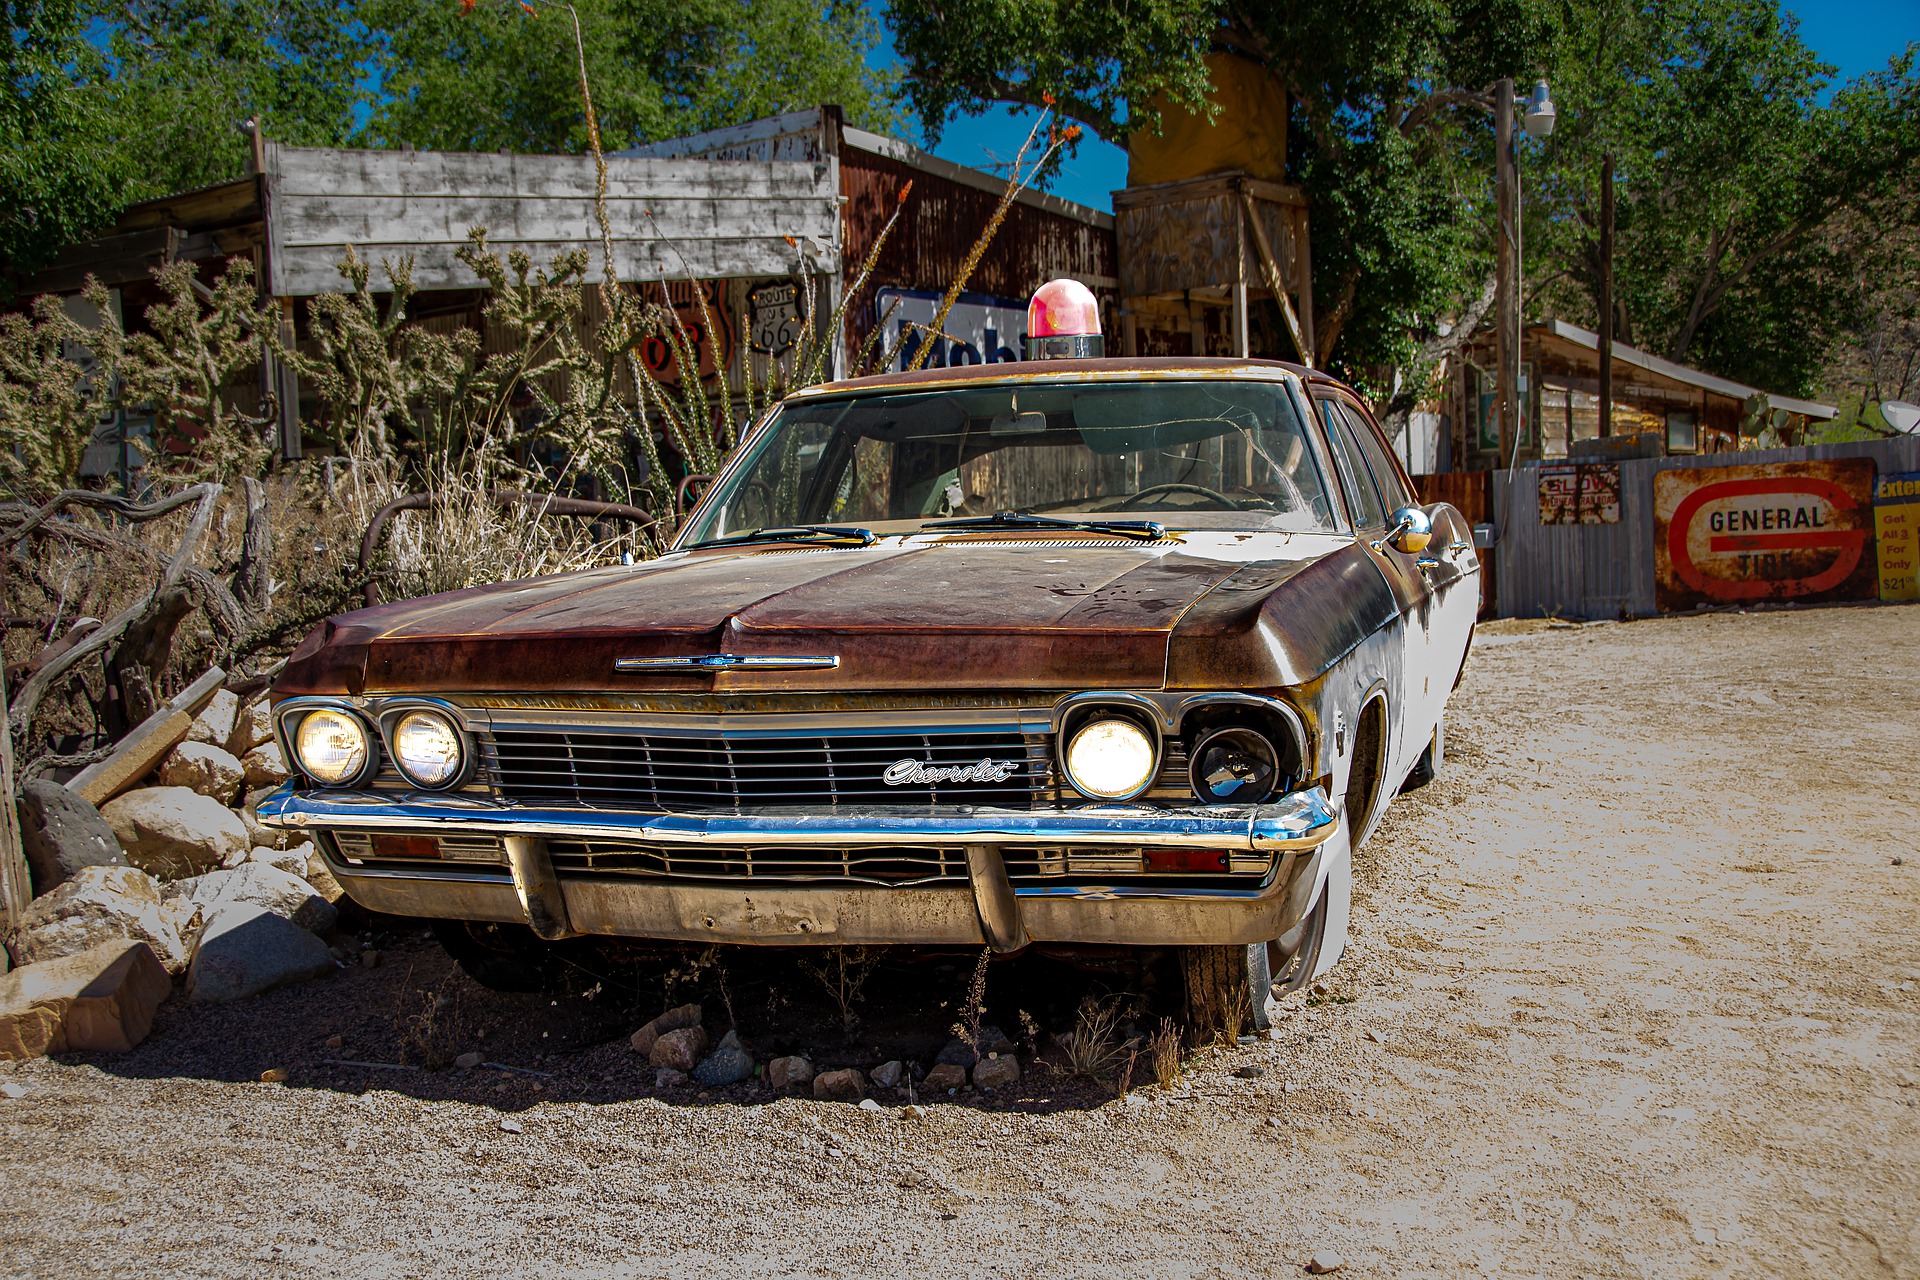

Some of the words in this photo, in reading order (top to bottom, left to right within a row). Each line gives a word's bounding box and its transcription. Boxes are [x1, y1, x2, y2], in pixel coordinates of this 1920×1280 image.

[759, 288, 792, 304] ROUTE
[761, 319, 790, 348] 66
[1547, 477, 1609, 492] SLOW
[1540, 496, 1580, 507] OVERHEA
[1710, 506, 1824, 532] GENERAL
[1883, 514, 1906, 524] Get
[1882, 529, 1898, 539] All
[1900, 529, 1909, 540] 3
[1886, 545, 1906, 554] For
[1738, 553, 1793, 577] TIRE
[1883, 560, 1911, 570] Only
[883, 758, 1019, 785] Chevrolet
